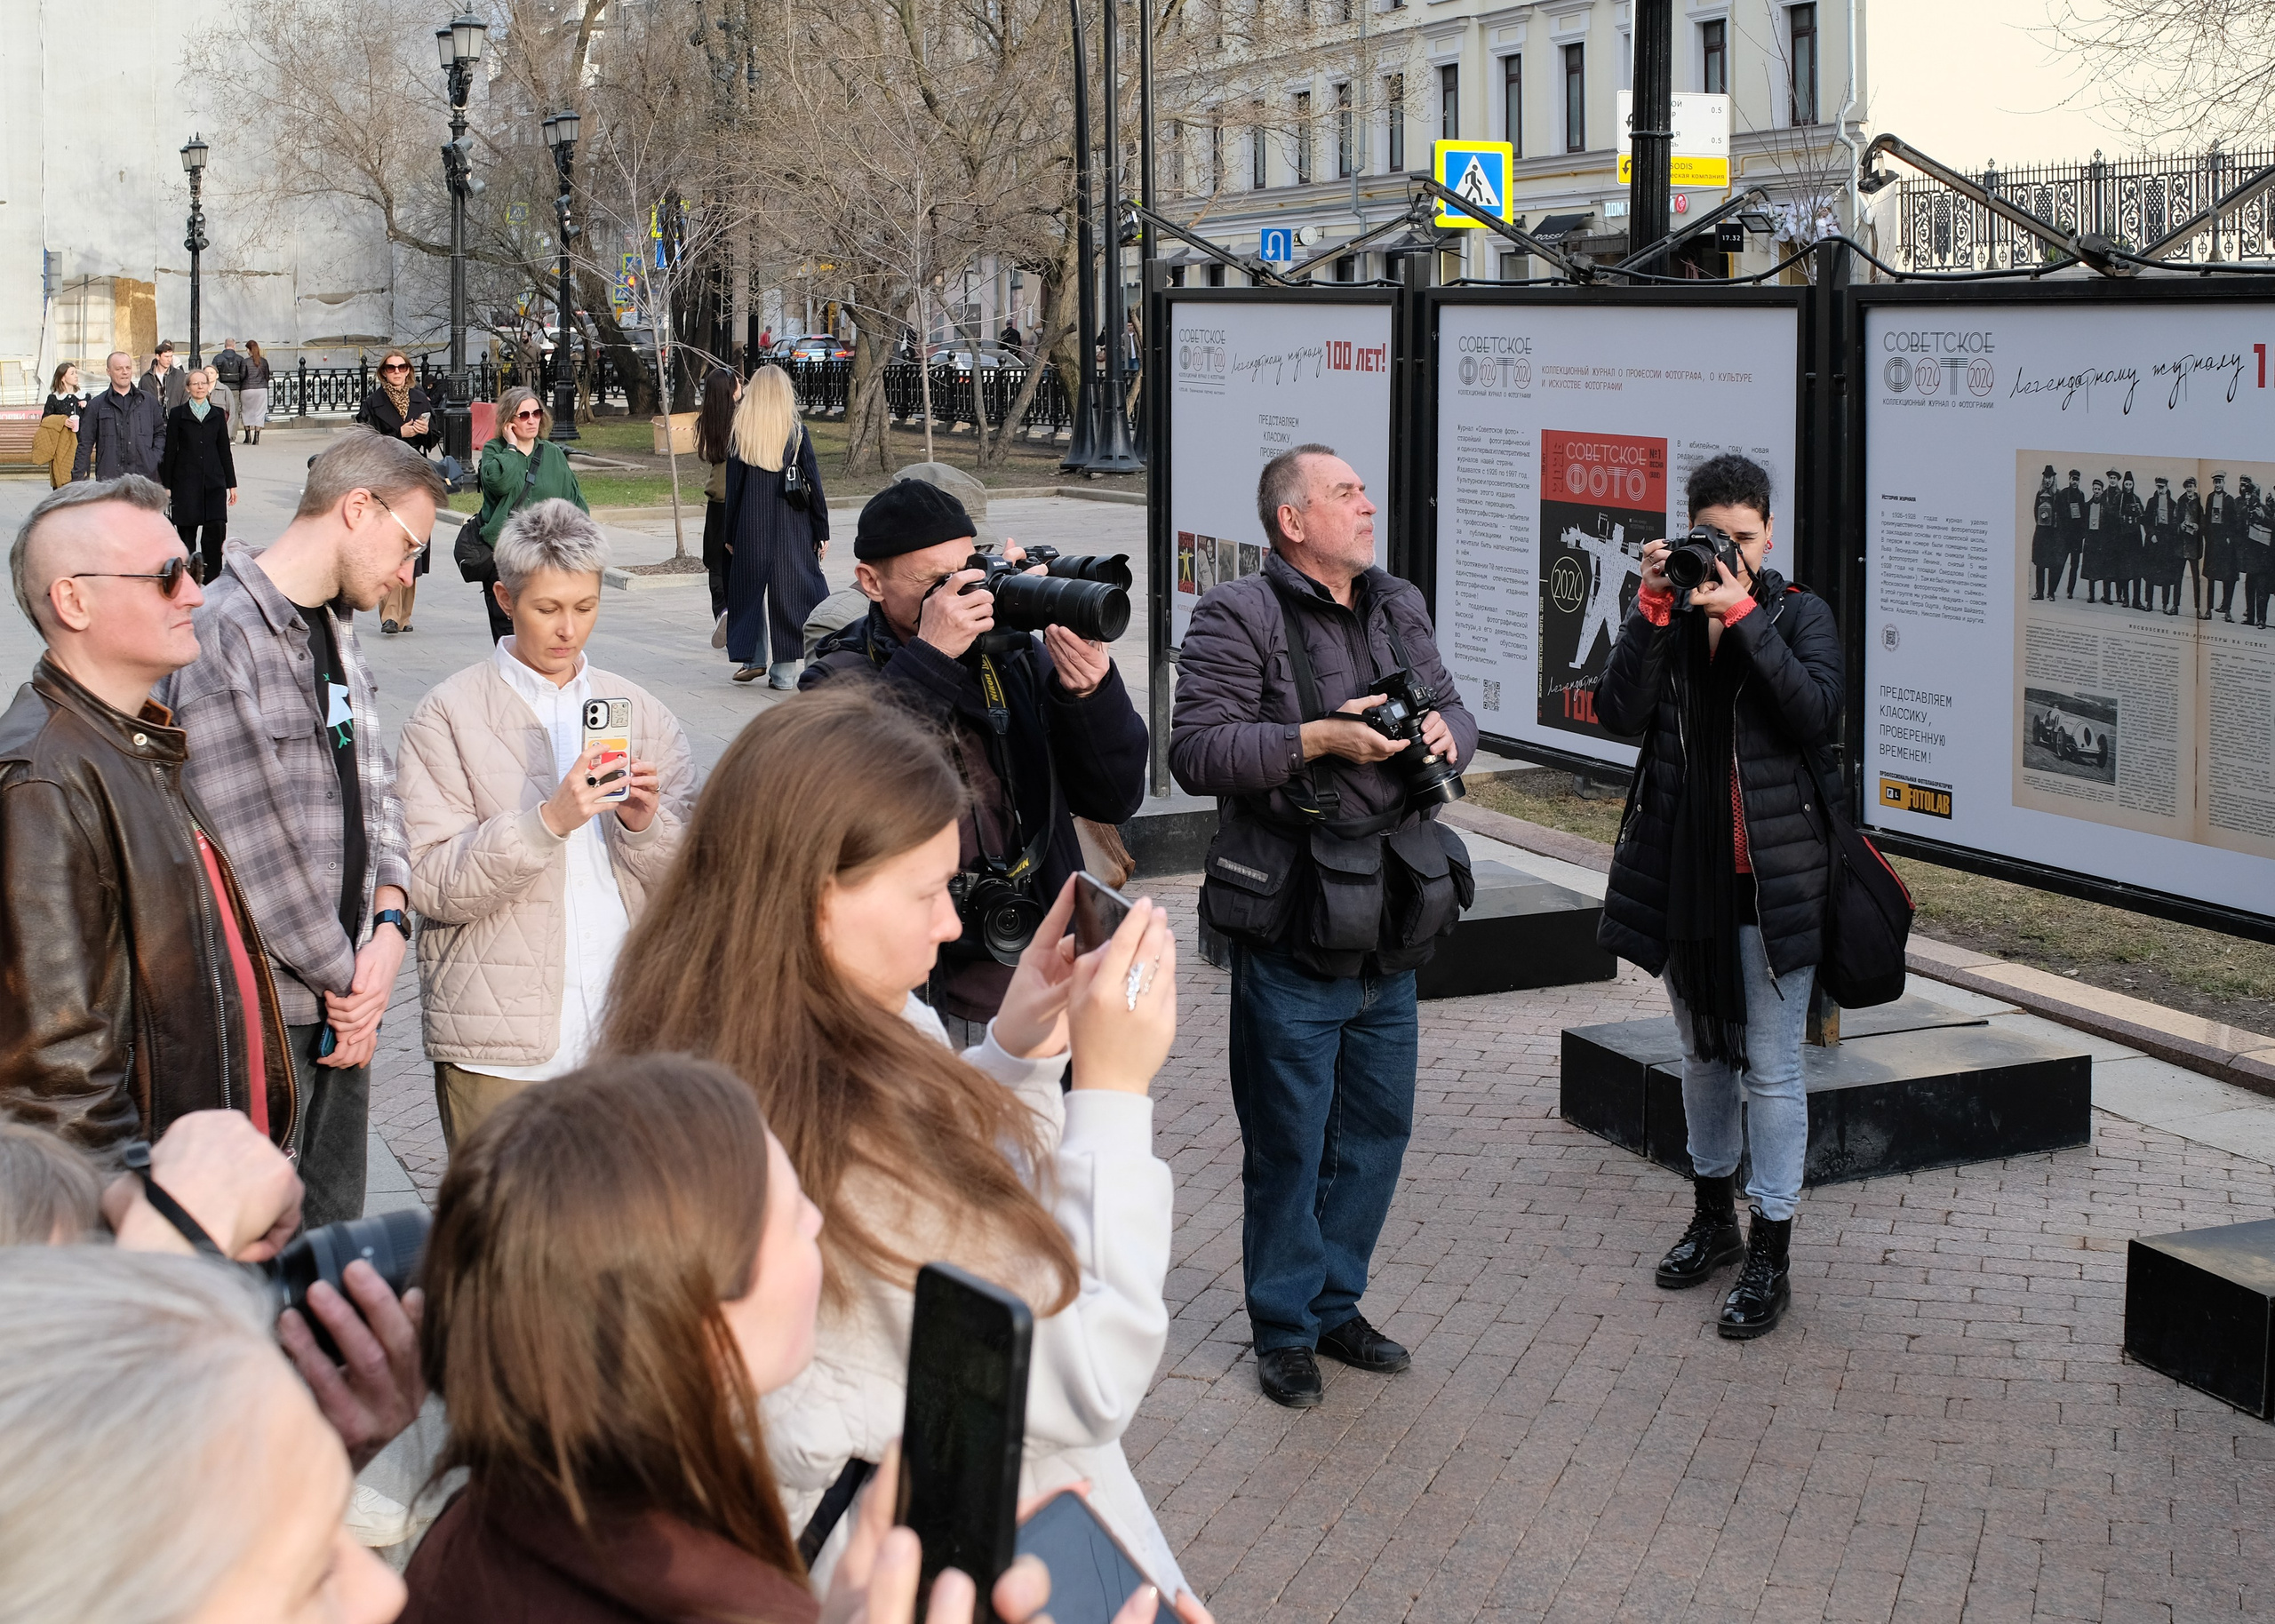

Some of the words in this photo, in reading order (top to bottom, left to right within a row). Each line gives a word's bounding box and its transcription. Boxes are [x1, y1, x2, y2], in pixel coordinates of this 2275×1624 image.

[1604, 202, 1624, 217] ДОМ
[1179, 328, 1225, 344] СОВЕТСКОЕ
[1884, 331, 1995, 354] СОВЕТСКОЕ
[1458, 336, 1532, 354] СОВЕТСКОЕ
[1326, 340, 1352, 370] 100
[1355, 343, 1385, 372] ЛЕТ!
[1541, 366, 1589, 376] КОЛЛЕКЦИОННЫЙ
[1592, 367, 1616, 377] ЖУРНАЛ
[1626, 369, 1662, 378] ПРОФЕССИИ
[1665, 370, 1705, 382] ФОТОГРАФА,
[1718, 373, 1752, 383] КУЛЬТУРЕ
[1548, 379, 1581, 389] ИСКУССТВЕ
[1585, 381, 1623, 391] ФОТОГРАФИИ
[1883, 398, 1926, 407] КОЛЛЕКЦИОННЫЙ
[1258, 414, 1298, 427] ПРЕДСТАВЛЯЕМ
[1264, 431, 1292, 445] КЛАССИКУ,
[1489, 437, 1530, 446] фотографический
[1566, 442, 1647, 466] СОВЕТСКОЕ
[1566, 464, 1646, 501] ФОТО
[1464, 519, 1498, 528] профессионалы
[1470, 529, 1501, 539] публикациями
[1456, 569, 1487, 579] единственным
[1493, 576, 1529, 585] отечественным
[1456, 580, 1495, 591] фотографическим
[1468, 603, 1497, 612] поддерживал
[1505, 609, 1528, 618] стандарт
[1487, 617, 1528, 628] фотографической
[1495, 629, 1528, 640] деятельность
[2173, 631, 2227, 643] ФОТО-РПОРТЕРЫ
[1455, 641, 1486, 653] формирование
[1503, 651, 1528, 661] советской
[1500, 640, 1528, 650] обусловила
[1547, 675, 1602, 704] Легендарно
[1880, 685, 1952, 707] ПРЕДСТАВЛЯЕМ
[1880, 705, 1932, 727] КЛАССИКУ,
[1880, 724, 1945, 747] ПРОВЕРЕННУЮ
[1880, 744, 1931, 764] ВРЕМЕНЕМ!
[1880, 770, 1917, 783] ПРОФЕССИОНАЛЬНАЯ
[1918, 778, 1952, 789] ФОТОЛАБОРАТОРИЯ
[1910, 788, 1950, 815] FOTOLAB
